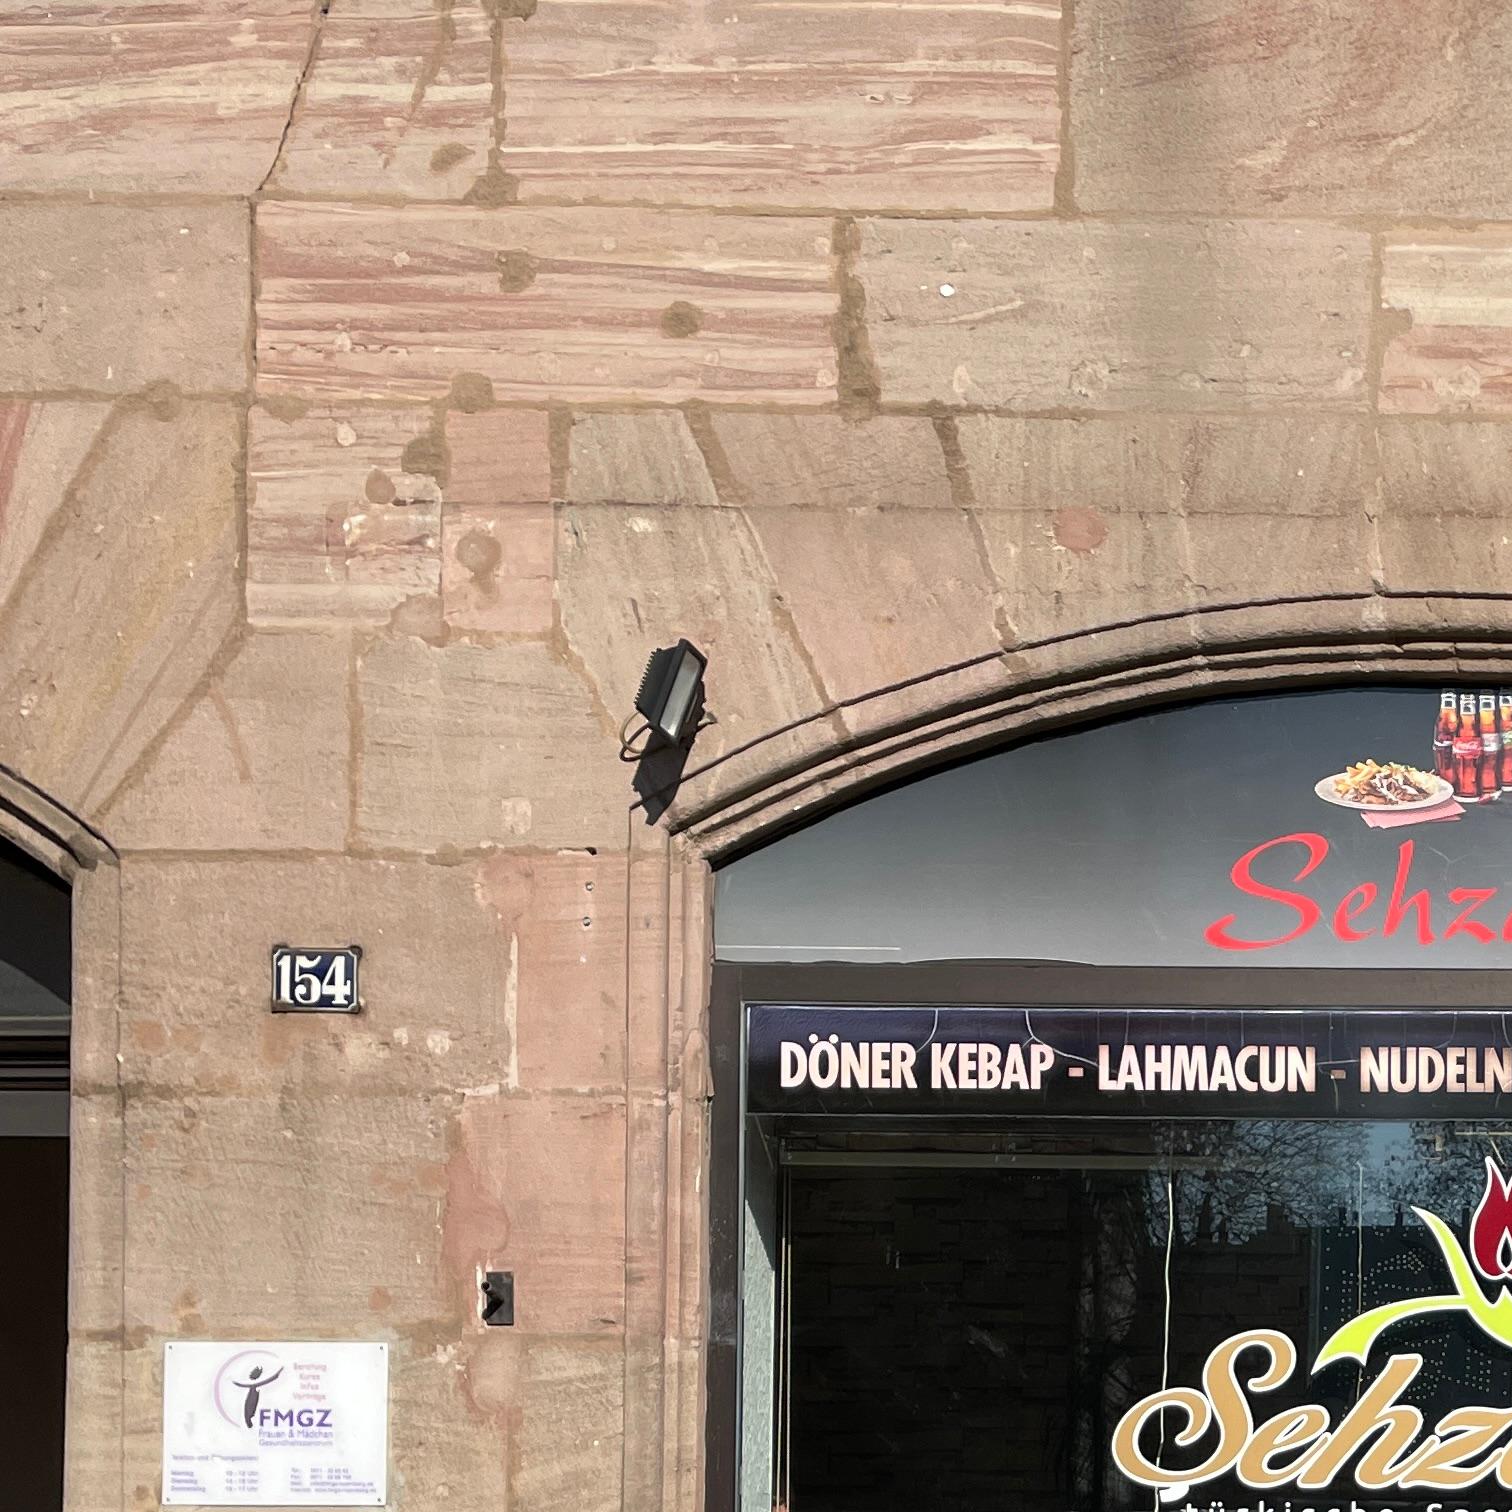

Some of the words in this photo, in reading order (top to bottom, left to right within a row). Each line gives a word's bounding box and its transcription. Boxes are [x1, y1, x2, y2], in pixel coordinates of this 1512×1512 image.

[276, 955, 351, 1004] 154
[779, 1033, 919, 1089] DÖNER
[931, 1043, 1054, 1091] KEBAP
[1099, 1044, 1315, 1092] LAHMACUN
[1360, 1046, 1512, 1093] NUDELN
[259, 1409, 332, 1427] FMGZ
